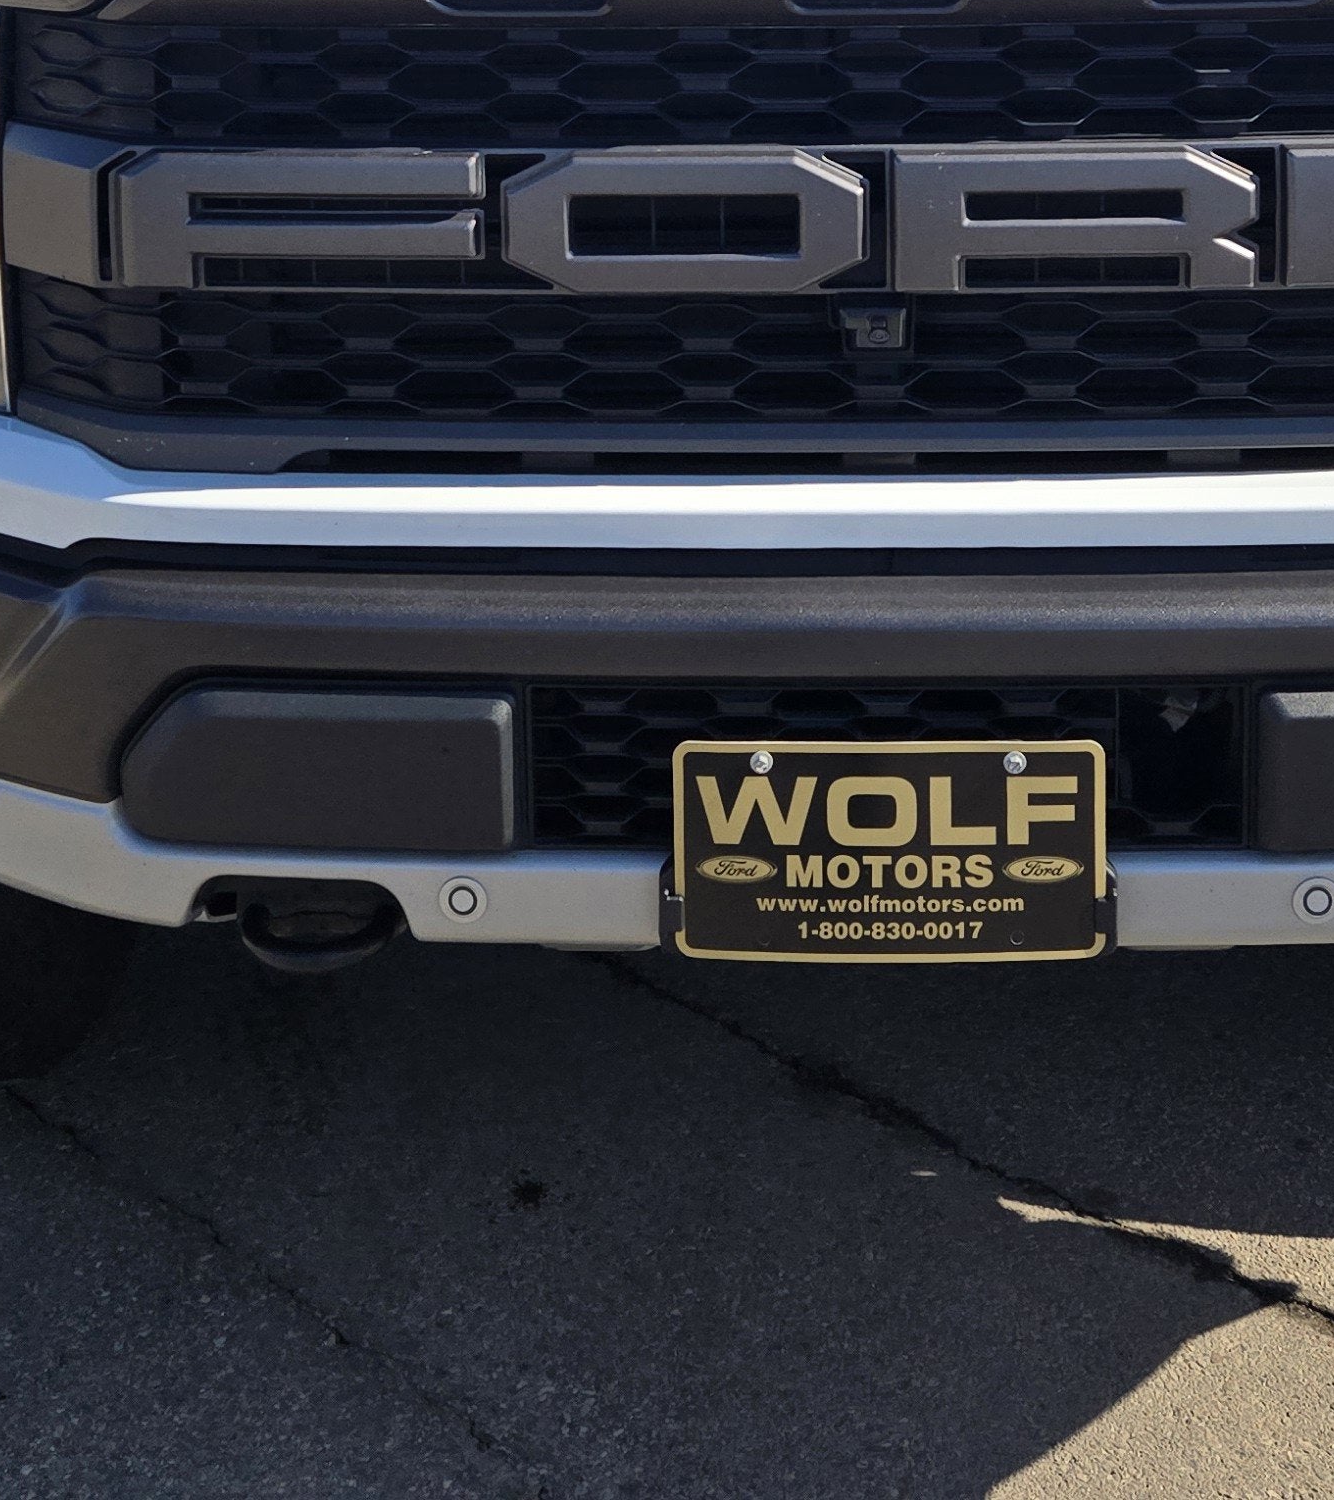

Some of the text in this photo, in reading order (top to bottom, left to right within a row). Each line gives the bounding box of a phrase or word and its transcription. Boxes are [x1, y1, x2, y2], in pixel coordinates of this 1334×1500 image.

[695, 775, 1079, 847] WOLF
[713, 858, 760, 879] Ford
[785, 854, 995, 889] MOTORS
[1019, 858, 1066, 878] Ford
[755, 894, 1025, 915] www.wolfmotors.com
[797, 920, 984, 940] 1-800-830-0017
